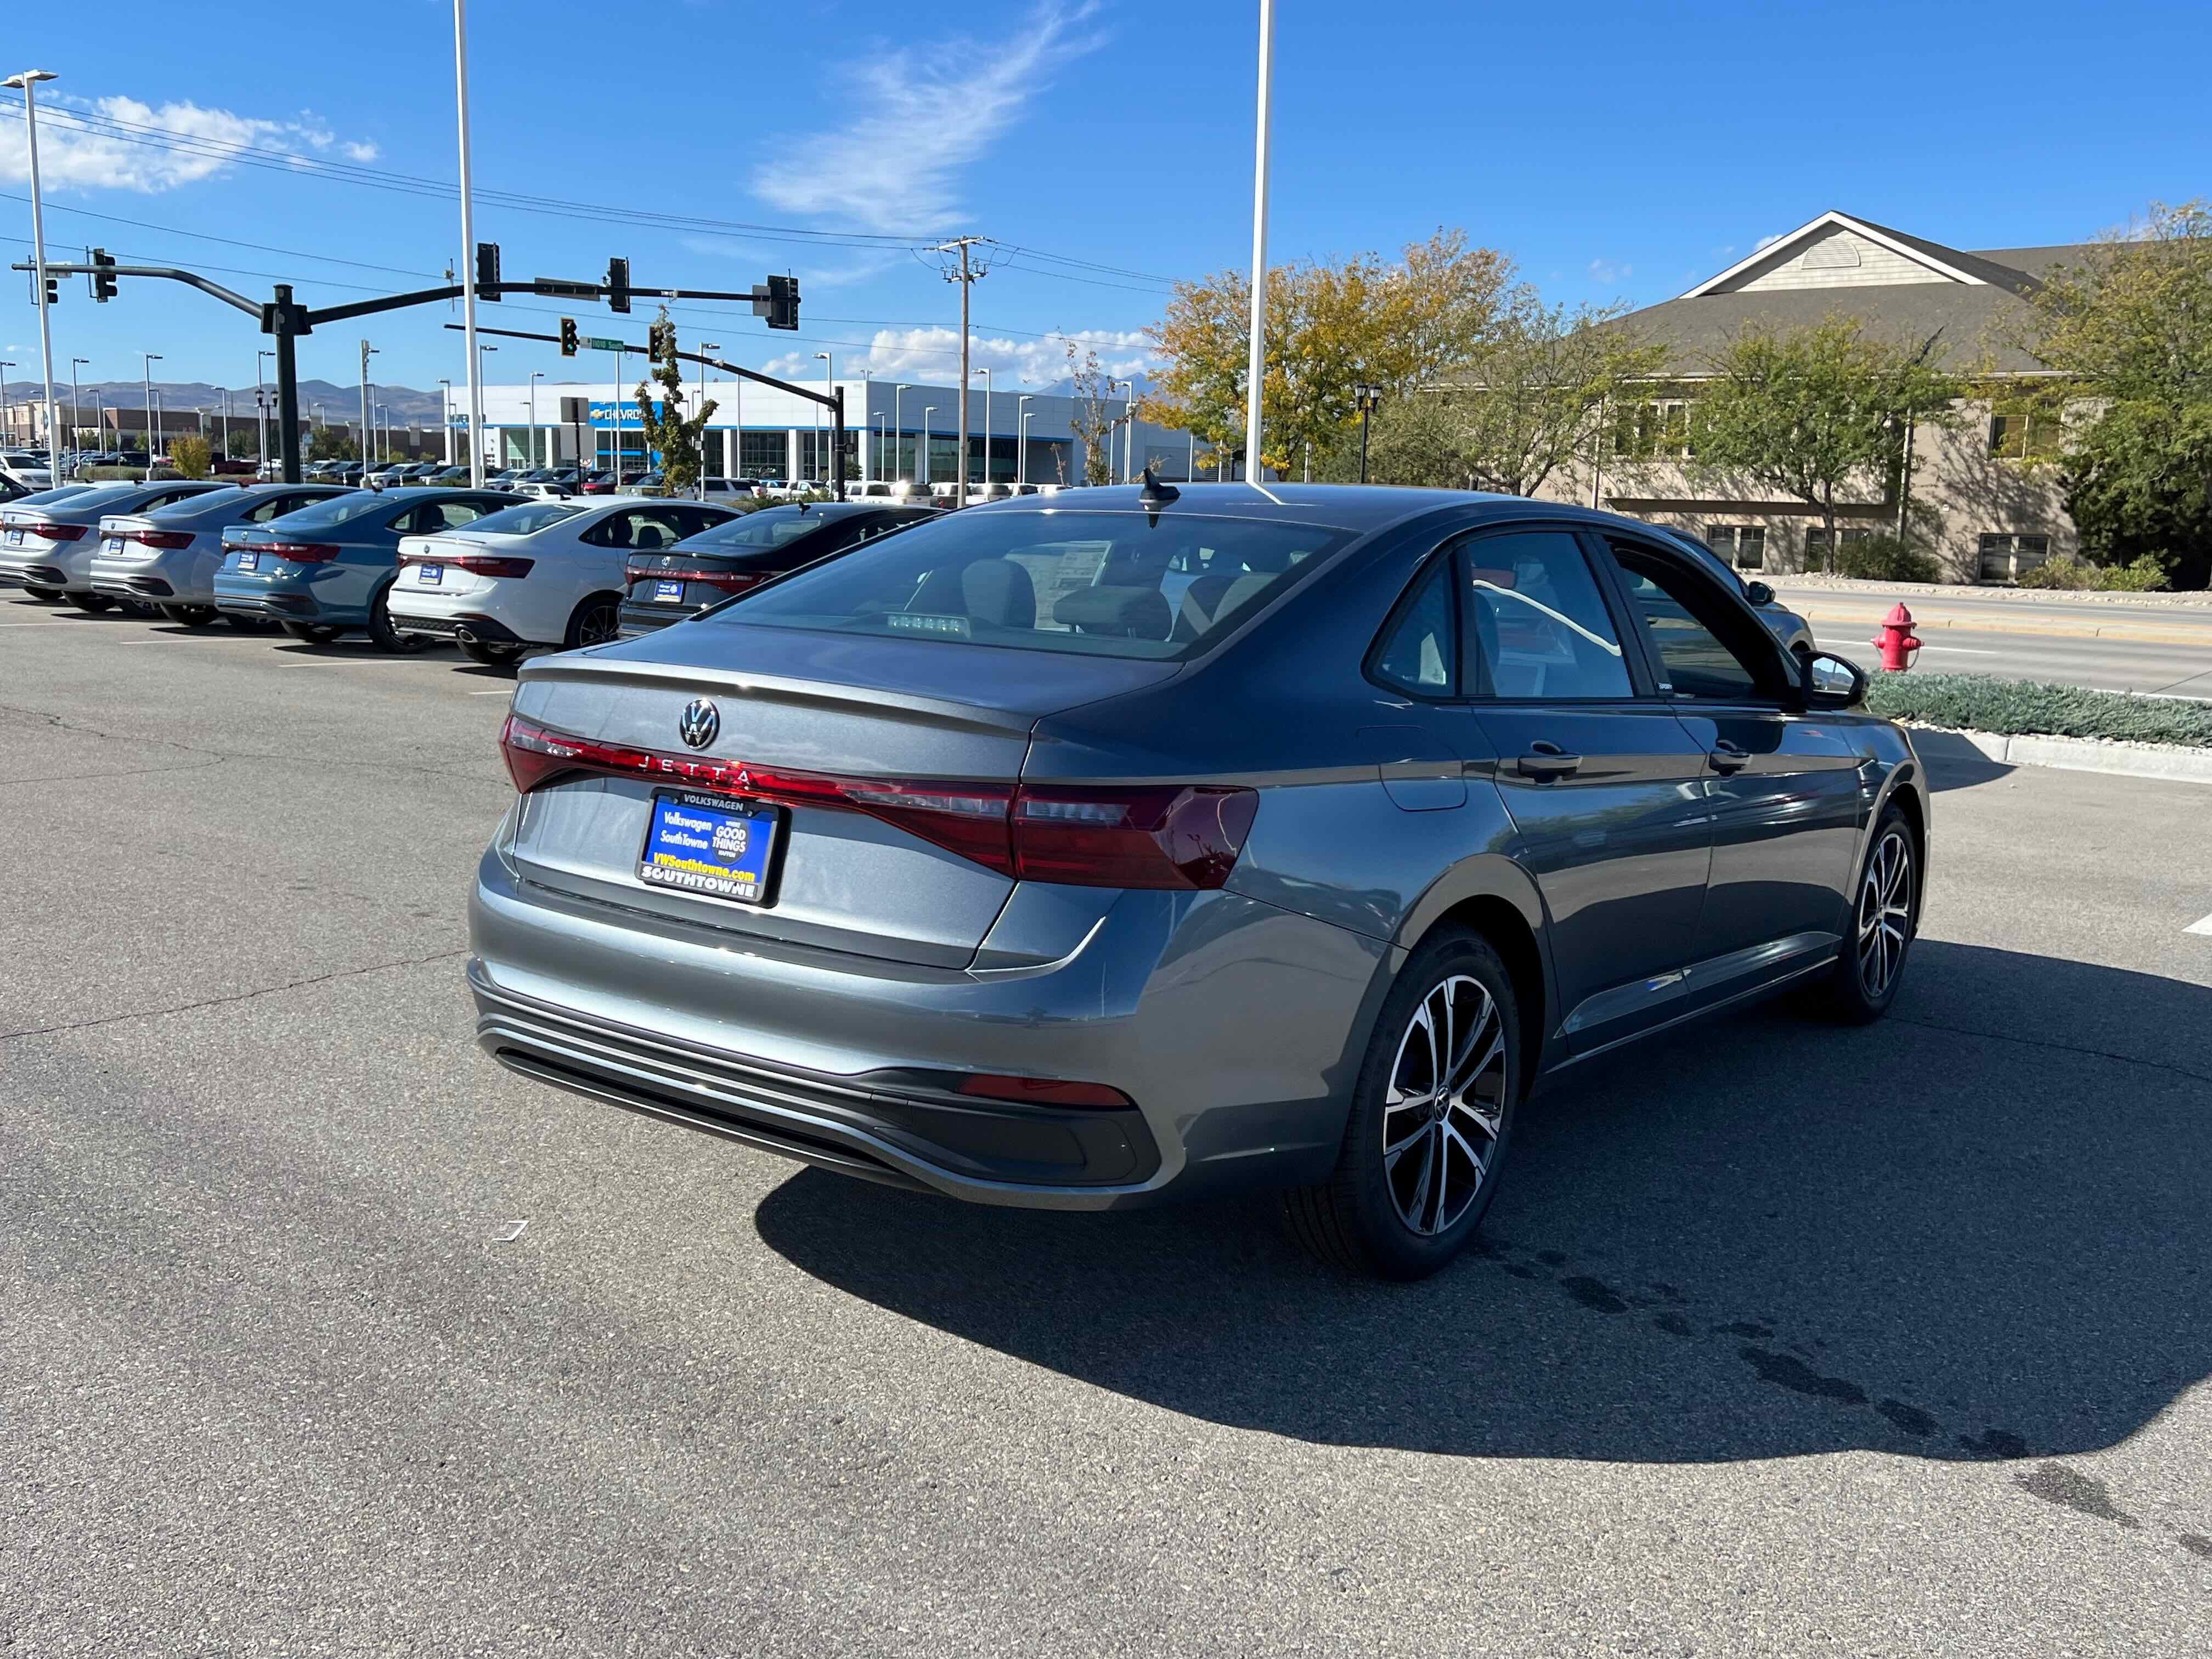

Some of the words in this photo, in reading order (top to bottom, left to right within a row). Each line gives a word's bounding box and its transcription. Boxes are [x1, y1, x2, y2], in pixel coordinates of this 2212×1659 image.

[638, 755, 751, 786] JETTA
[684, 794, 744, 811] VOLKSWAGEN
[664, 811, 712, 833] Volkswagen
[715, 825, 746, 841] GOOD
[653, 851, 755, 882] VWSouthtowne.com
[641, 865, 755, 898] SOUTHTOWNE
